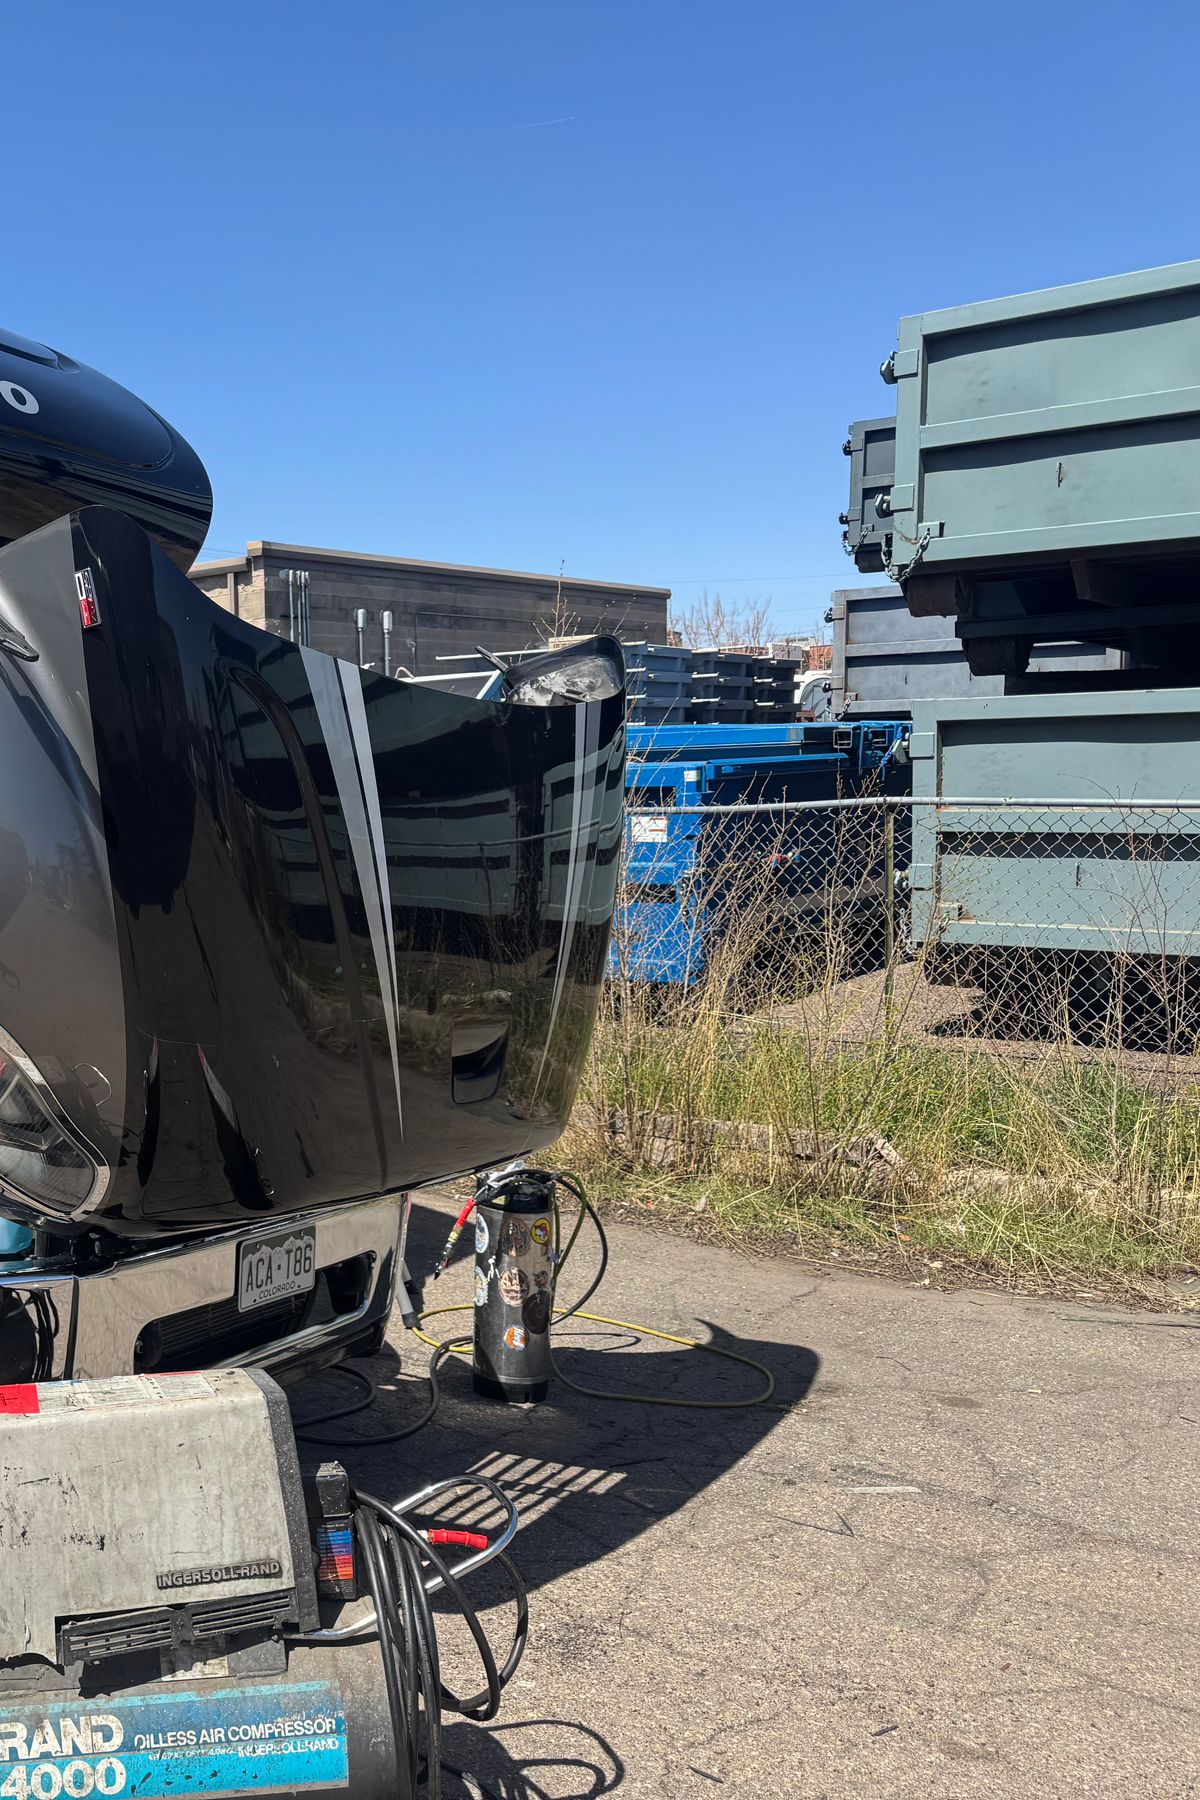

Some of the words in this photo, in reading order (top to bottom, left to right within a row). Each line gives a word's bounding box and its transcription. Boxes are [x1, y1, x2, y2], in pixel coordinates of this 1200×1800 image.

[259, 1281, 296, 1299] COLORADO
[157, 1562, 280, 1588] INGERSOLL-RAND
[134, 1732, 197, 1750] OILLESS
[200, 1727, 225, 1743] AIR
[228, 1719, 336, 1741] COMPRESSOR
[1, 1757, 126, 1800] 4000
